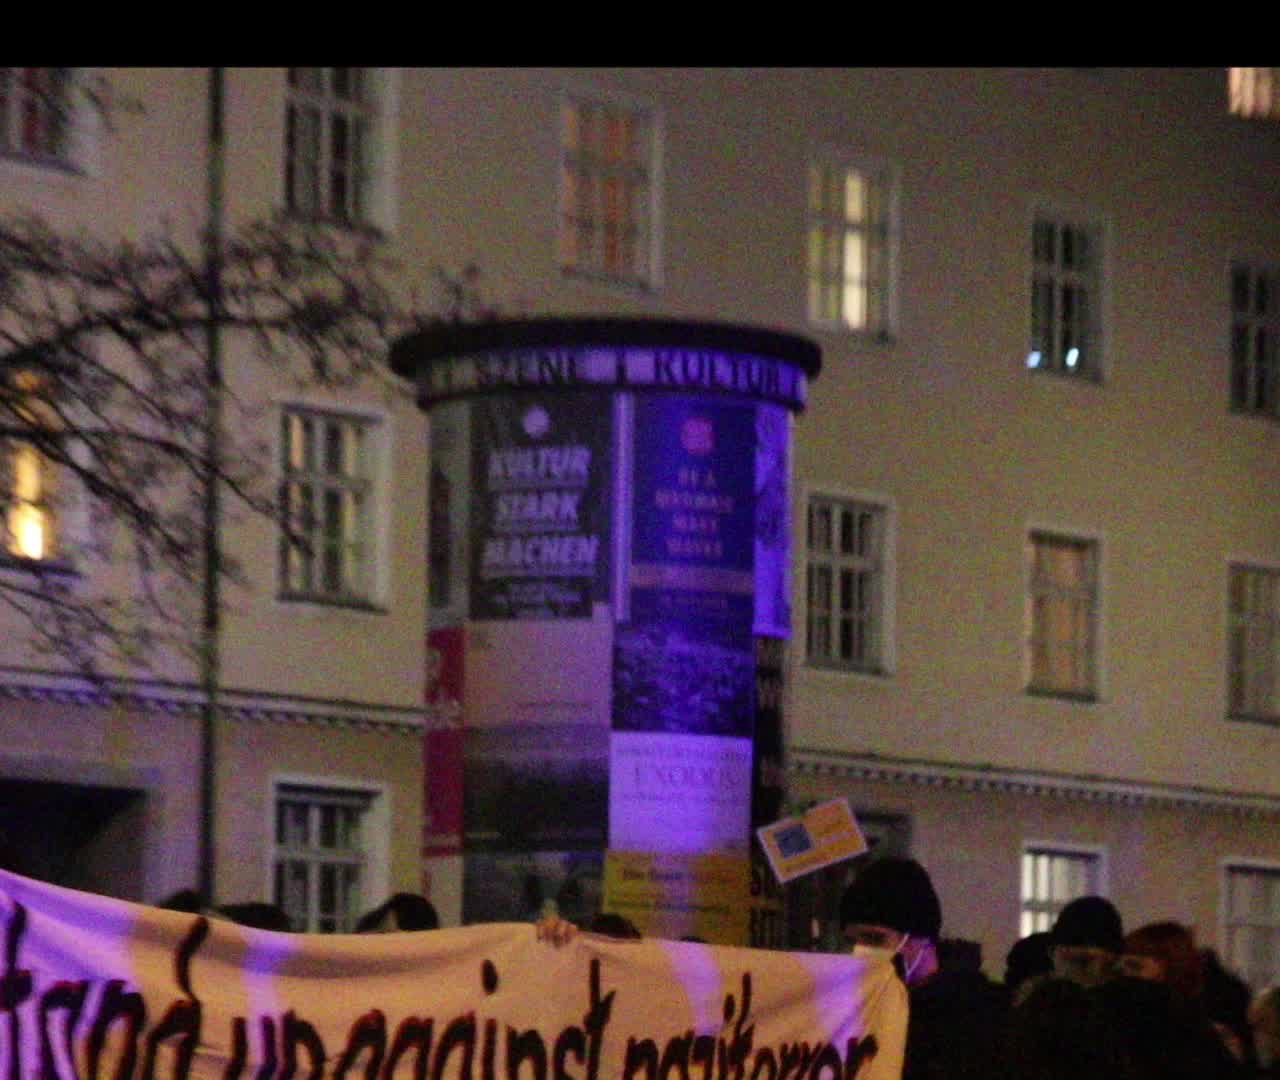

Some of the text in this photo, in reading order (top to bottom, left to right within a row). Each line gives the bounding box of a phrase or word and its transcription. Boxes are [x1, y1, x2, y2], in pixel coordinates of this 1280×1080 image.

[653, 346, 780, 394] KULTUR
[489, 447, 592, 480] KULTUR
[496, 493, 580, 522] STARK
[482, 536, 599, 567] MACHEN
